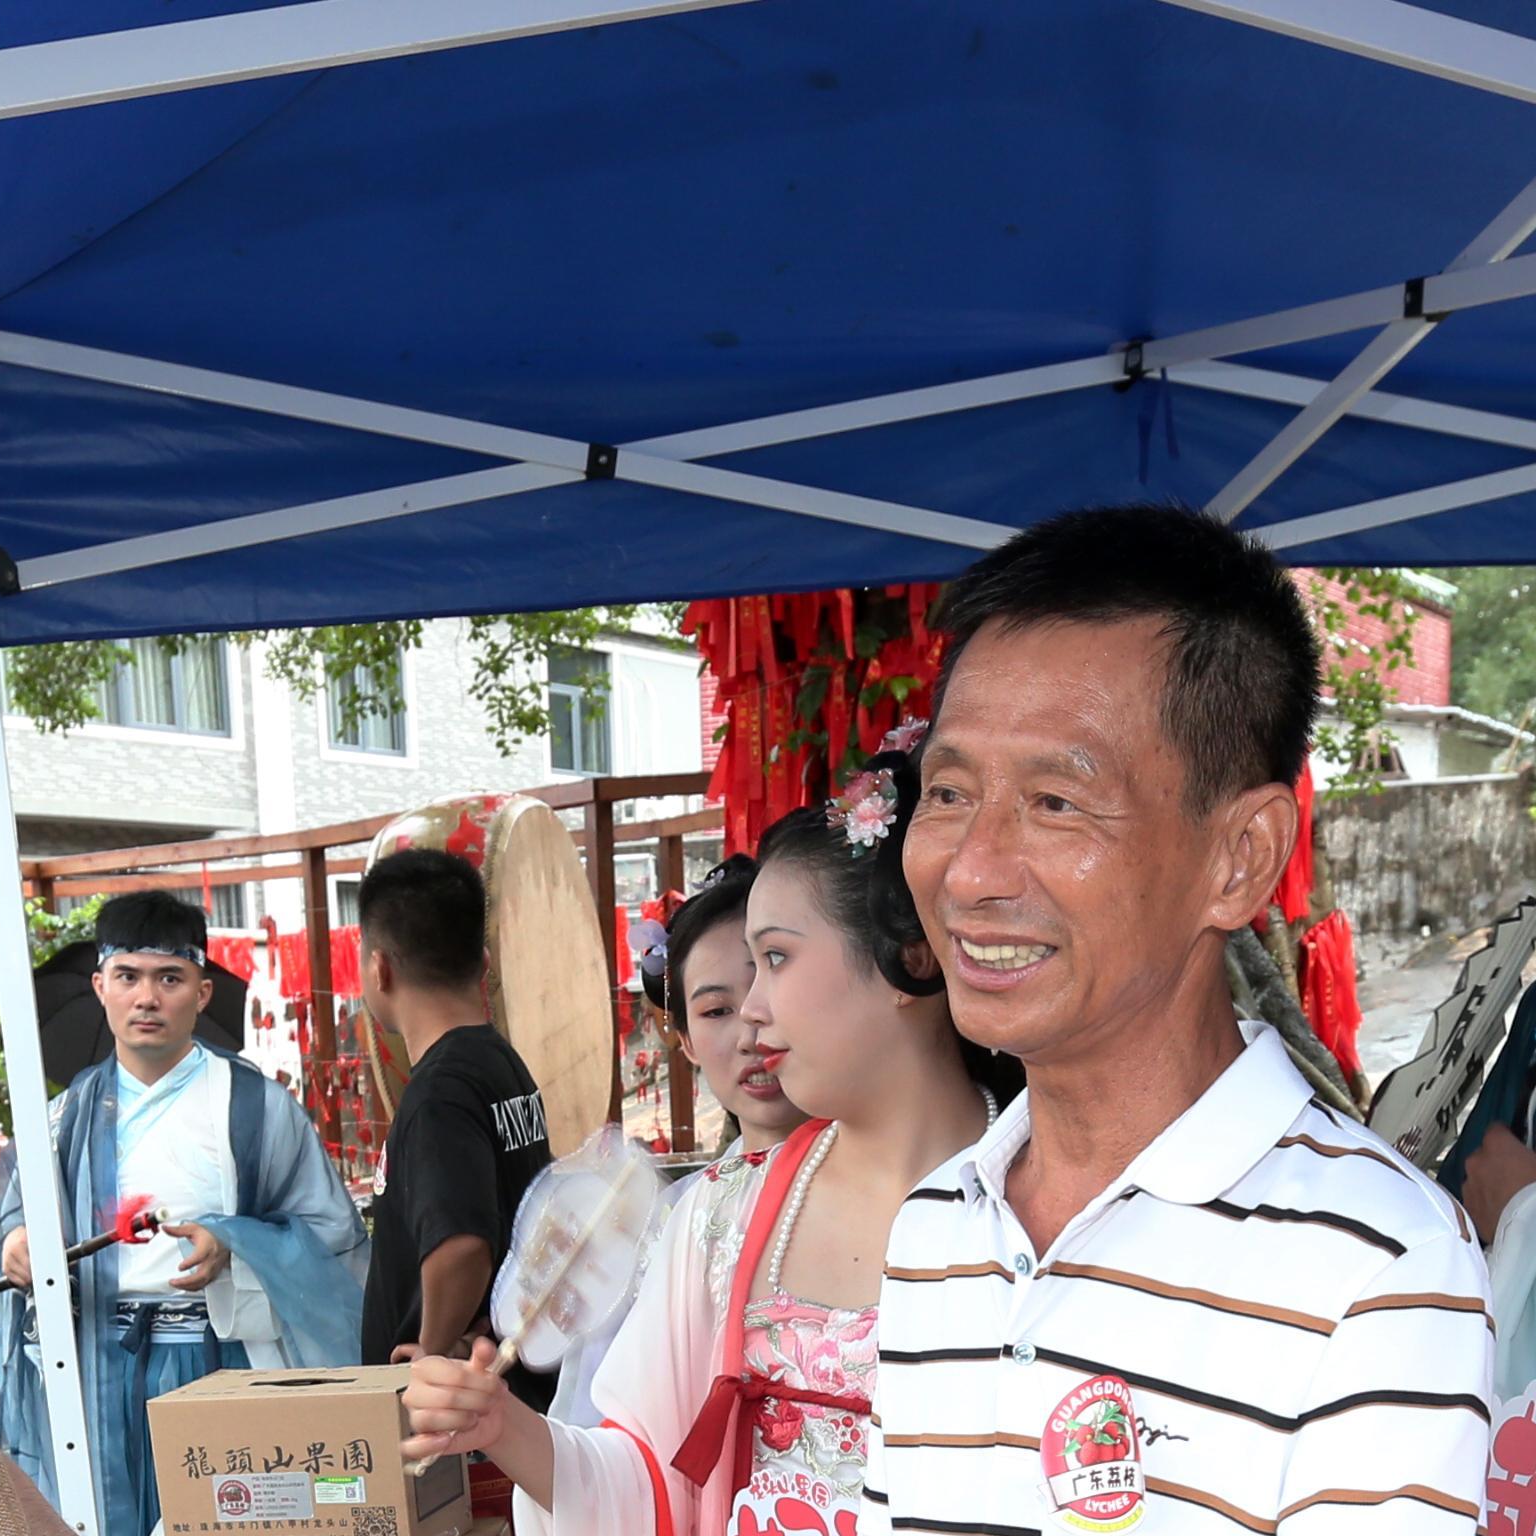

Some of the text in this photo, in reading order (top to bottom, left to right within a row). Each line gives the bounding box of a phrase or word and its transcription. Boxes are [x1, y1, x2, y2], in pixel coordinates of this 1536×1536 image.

[1051, 1381, 1135, 1433] GUANGDONG
[181, 1439, 373, 1479] 龍頭山果園
[1072, 1466, 1135, 1496] 广东荔枝
[1084, 1493, 1130, 1514] LYCHEE
